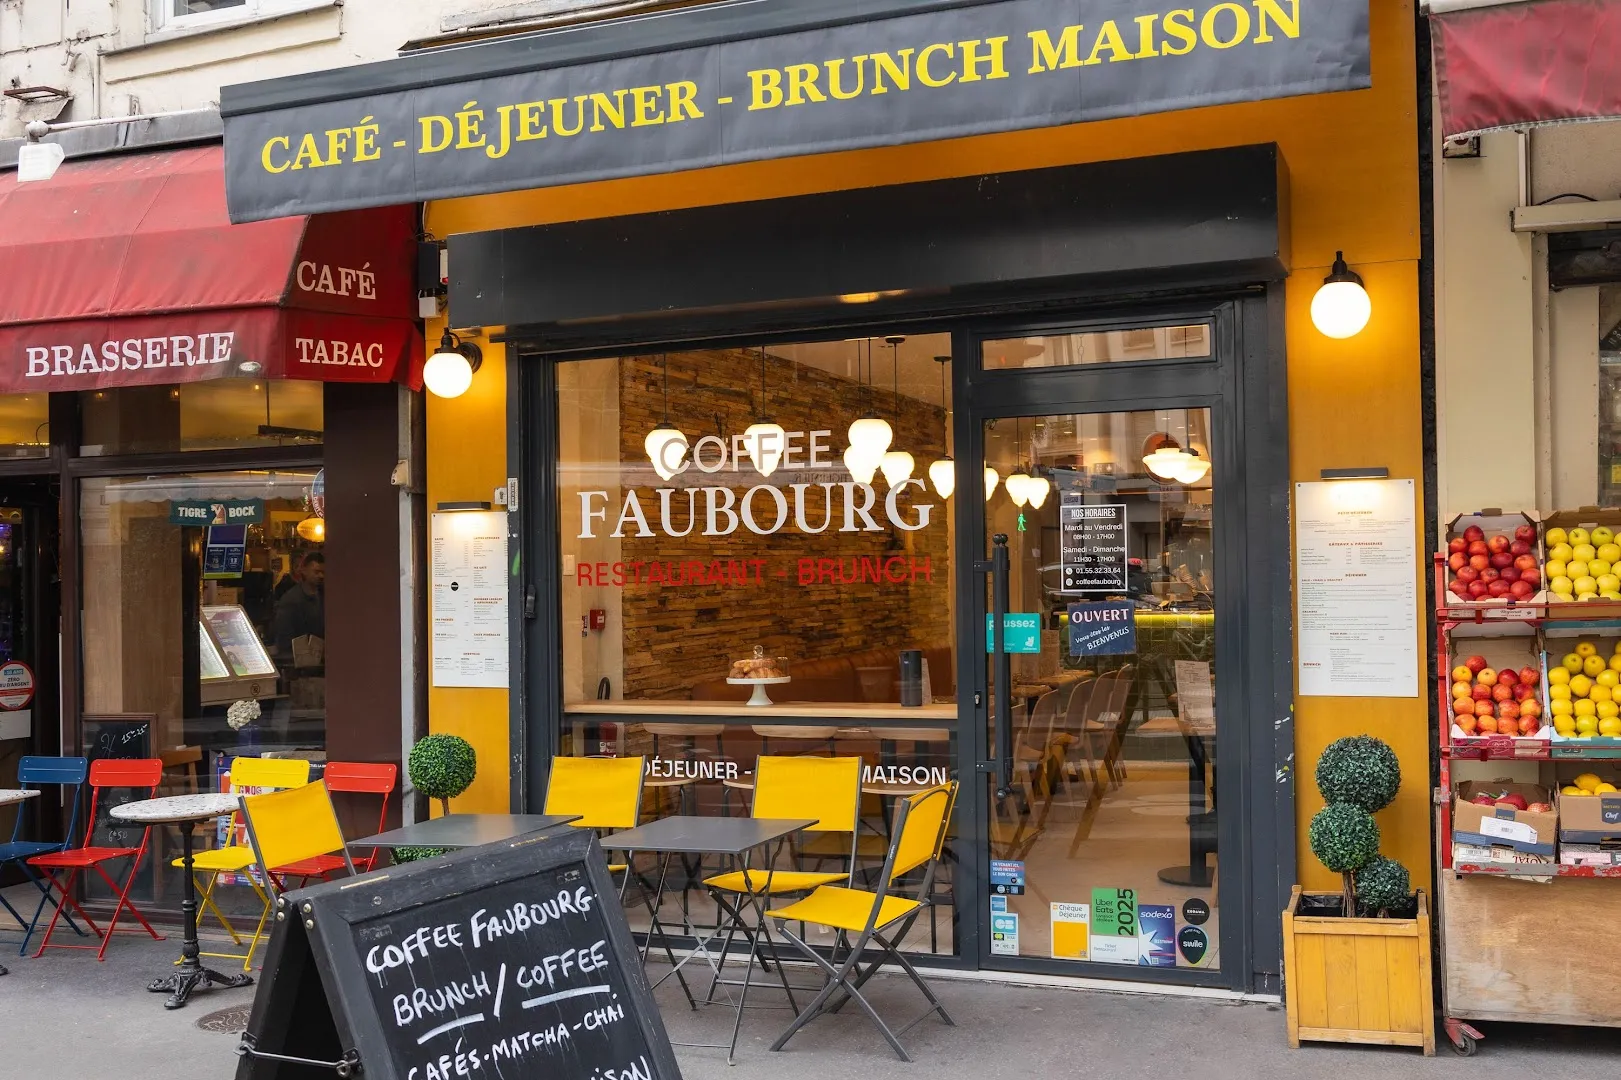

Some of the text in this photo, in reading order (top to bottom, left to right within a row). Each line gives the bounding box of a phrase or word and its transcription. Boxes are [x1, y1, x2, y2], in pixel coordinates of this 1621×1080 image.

[261, 116, 381, 174] CAFÉ
[418, 80, 704, 159] DÉJEUNER
[747, 35, 1008, 111] BRUNCH
[1027, 0, 1301, 75] MAISON
[297, 262, 377, 300] CAFÉ
[25, 332, 235, 377] BRASSERIE
[295, 337, 383, 367] TABAC
[660, 429, 832, 475] COFFEE
[178, 505, 256, 518] TIGRE BOCK
[577, 479, 934, 539] FAUBOURG
[1071, 508, 1116, 517] NOS HORAIRES
[1093, 545, 1125, 553] Dimanche
[577, 559, 767, 587] RESTAURANT
[799, 556, 932, 585] BRUNCH
[1075, 578, 1121, 586] coffeefaubourg
[989, 620, 1035, 630] pussez
[1072, 609, 1129, 623] OUVERT
[1075, 635, 1090, 644] Vous
[1087, 626, 1130, 650] BIENVENUS
[1059, 904, 1083, 912] Chèque
[1117, 888, 1134, 936] 2025
[1140, 911, 1172, 919] sodexo
[366, 923, 463, 974] COFFEE
[1182, 940, 1203, 948] swile
[393, 970, 492, 1026] BRUNCH
[516, 940, 609, 988] COFFEE
